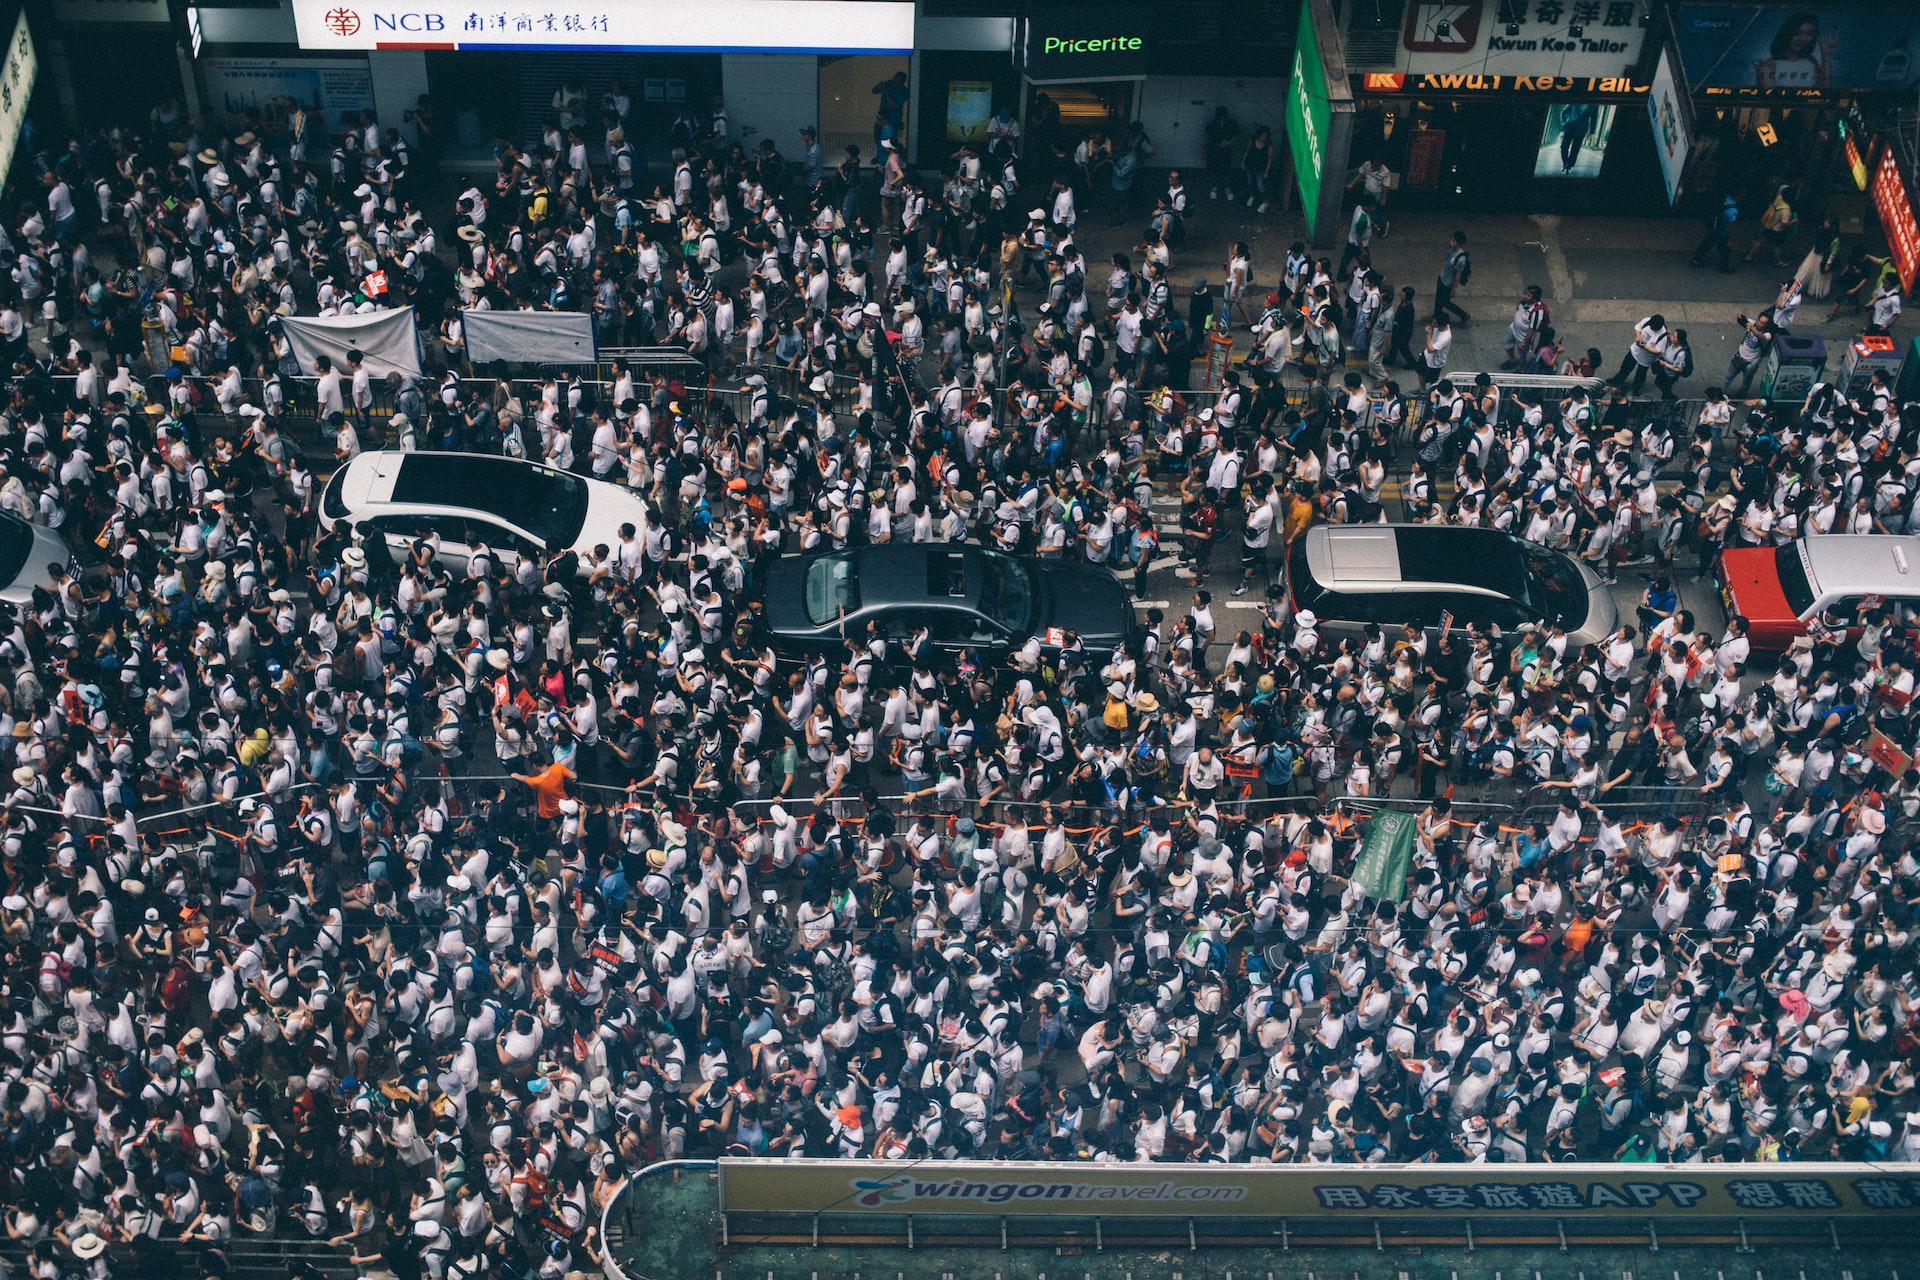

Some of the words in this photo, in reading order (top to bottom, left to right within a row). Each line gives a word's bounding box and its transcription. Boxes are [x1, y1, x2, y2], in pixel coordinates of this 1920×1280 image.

[374, 13, 445, 31] NCB
[464, 11, 610, 34] 南洋商業銀行
[1044, 36, 1142, 54] Pricerite
[1488, 37, 1537, 51] Kwun
[1541, 38, 1577, 52] Kee
[1580, 39, 1628, 53] Tailor
[1294, 49, 1321, 180] Pricerite
[914, 1179, 1245, 1203] wingontravel.com
[1318, 1183, 1703, 1208] 用永安旅遊APP
[1730, 1181, 1838, 1208] 想飛
[1855, 1180, 1920, 1208] 就
